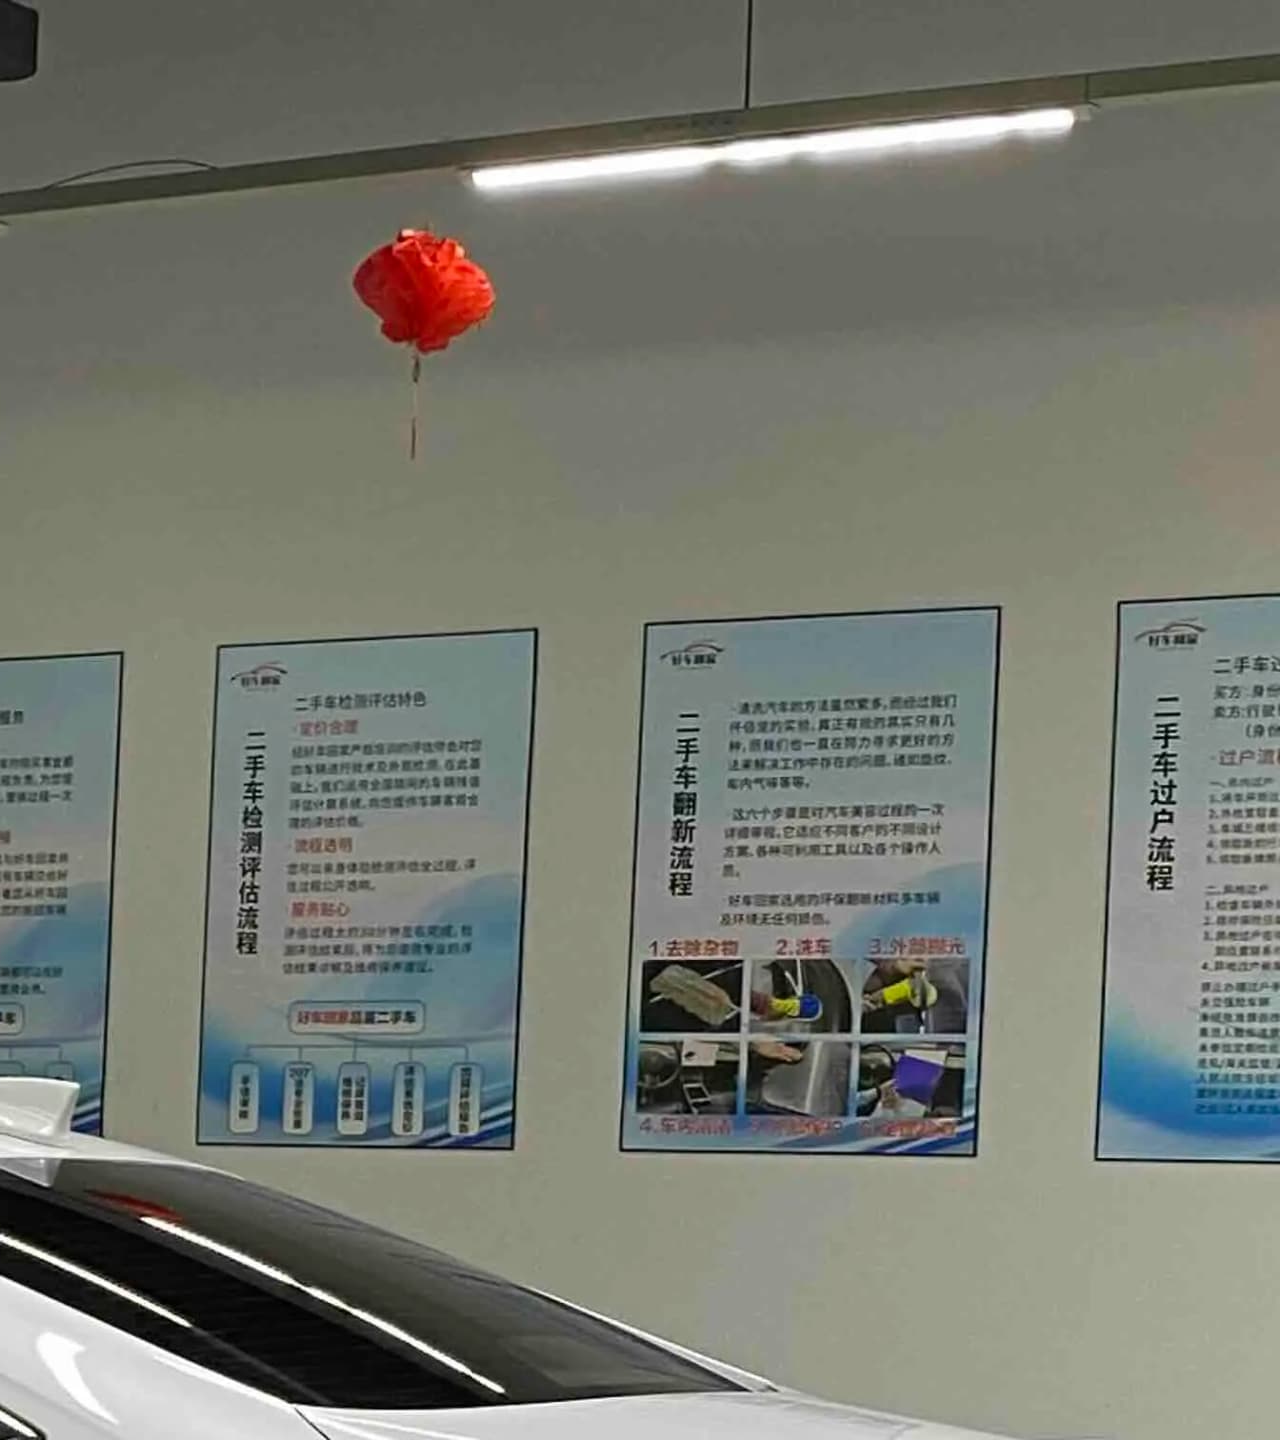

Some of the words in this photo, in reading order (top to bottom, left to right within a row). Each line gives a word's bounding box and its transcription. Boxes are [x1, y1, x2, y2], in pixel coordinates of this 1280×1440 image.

[295, 692, 427, 711] 二手车检测评估特色
[1146, 696, 1181, 891] 二手车过户流程
[236, 731, 267, 955] 二手车检测评估流程
[669, 712, 701, 897] 二手车翻新流程
[776, 938, 832, 956] 2.洗车
